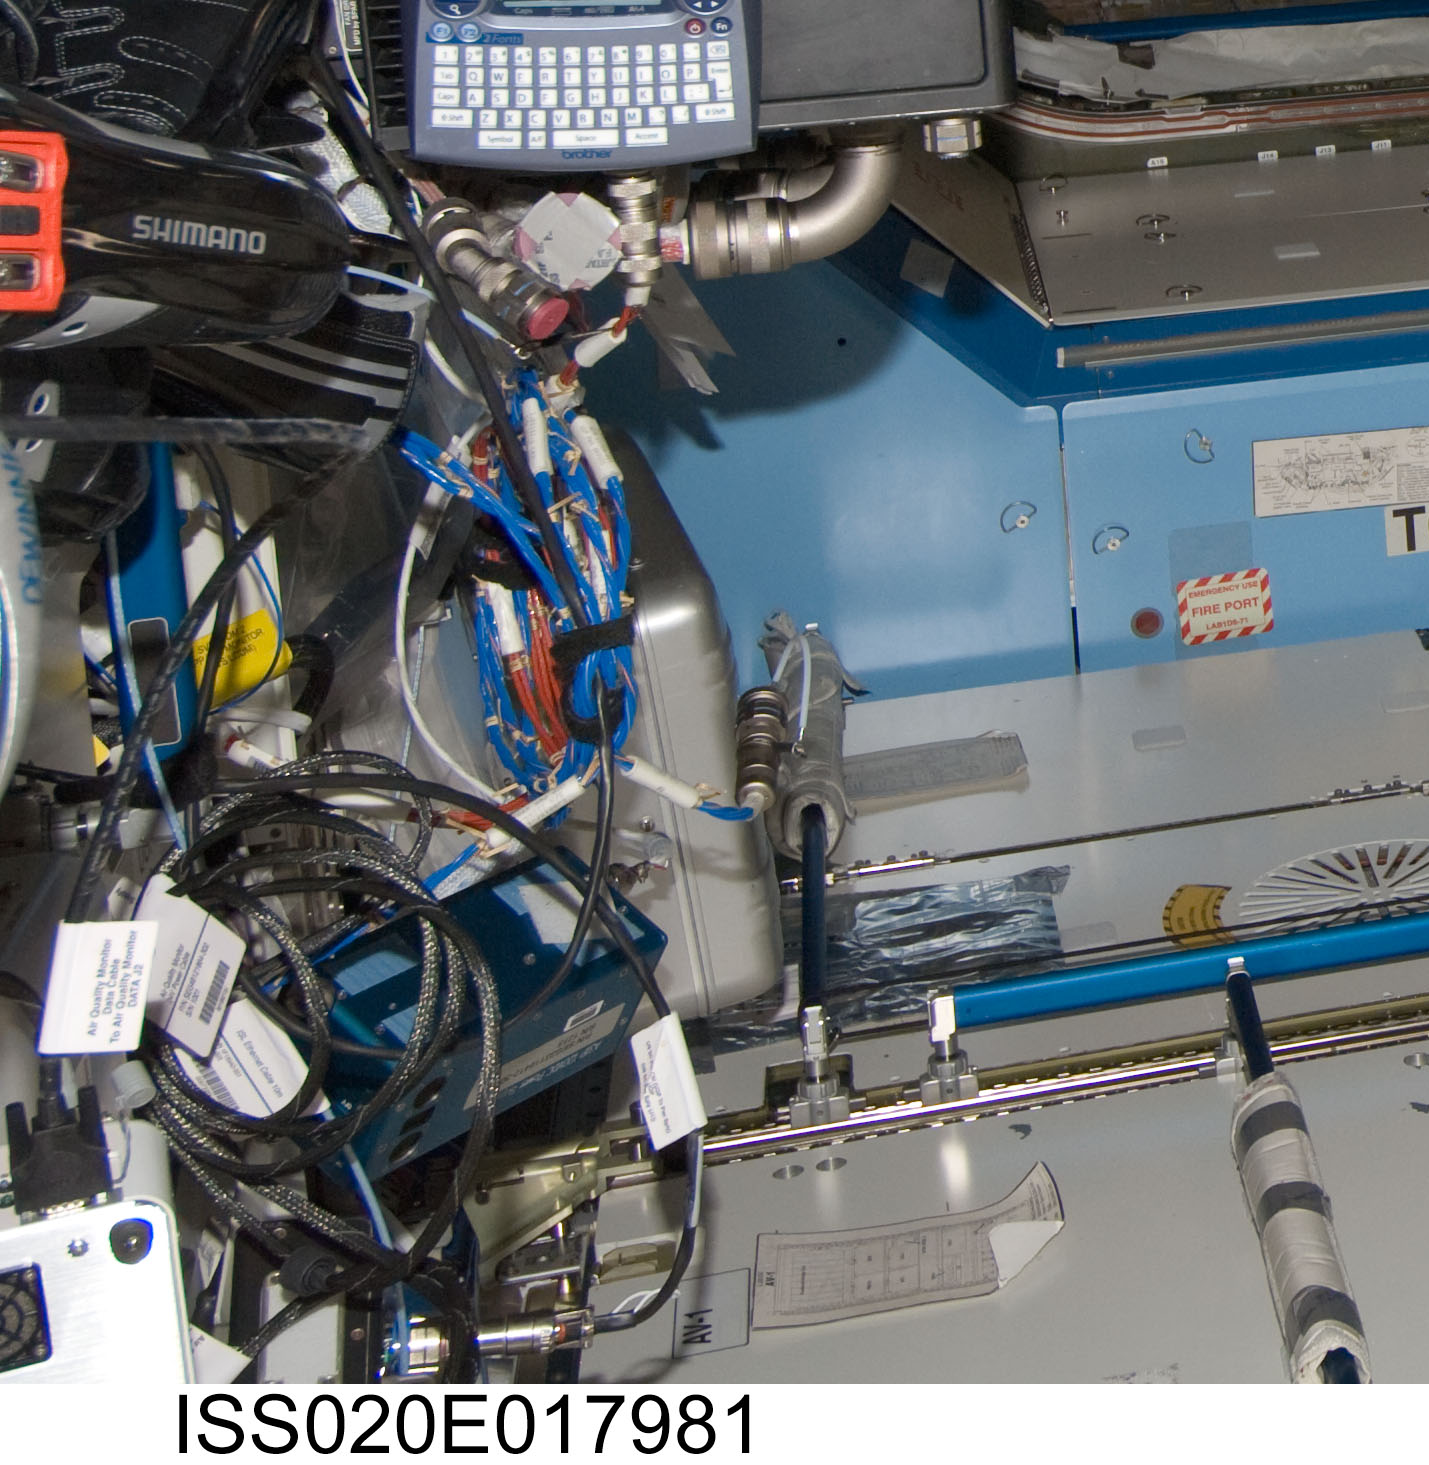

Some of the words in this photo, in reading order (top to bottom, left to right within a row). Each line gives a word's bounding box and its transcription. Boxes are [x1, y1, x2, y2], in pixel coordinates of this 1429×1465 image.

[344, 13, 352, 24] FAN
[350, 0, 358, 18] SPAR
[716, 22, 728, 30] Fn
[353, 28, 361, 44] MFD
[562, 149, 612, 159] brother
[132, 214, 268, 255] SHIMANO
[1189, 584, 1240, 599] EMERGENCY
[1242, 580, 1258, 589] USE
[1192, 603, 1222, 617] FIRE
[1224, 597, 1259, 612] PORT
[95, 937, 112, 978] Monitor
[121, 929, 137, 969] Monitor
[106, 957, 120, 988] Cable
[133, 962, 144, 975] J2
[89, 979, 108, 1018] Quality
[115, 972, 130, 1010] Quality
[127, 977, 141, 1008] DATA
[102, 989, 115, 1015] Data
[87, 1020, 97, 1035] Air
[112, 1011, 122, 1026] Air
[109, 1029, 120, 1043] To
[235, 1027, 249, 1042] ISL
[242, 1039, 266, 1068] Ethernet
[258, 1064, 278, 1087] Cable
[765, 1270, 775, 1285] AV-1
[682, 1307, 713, 1344] AV-1
